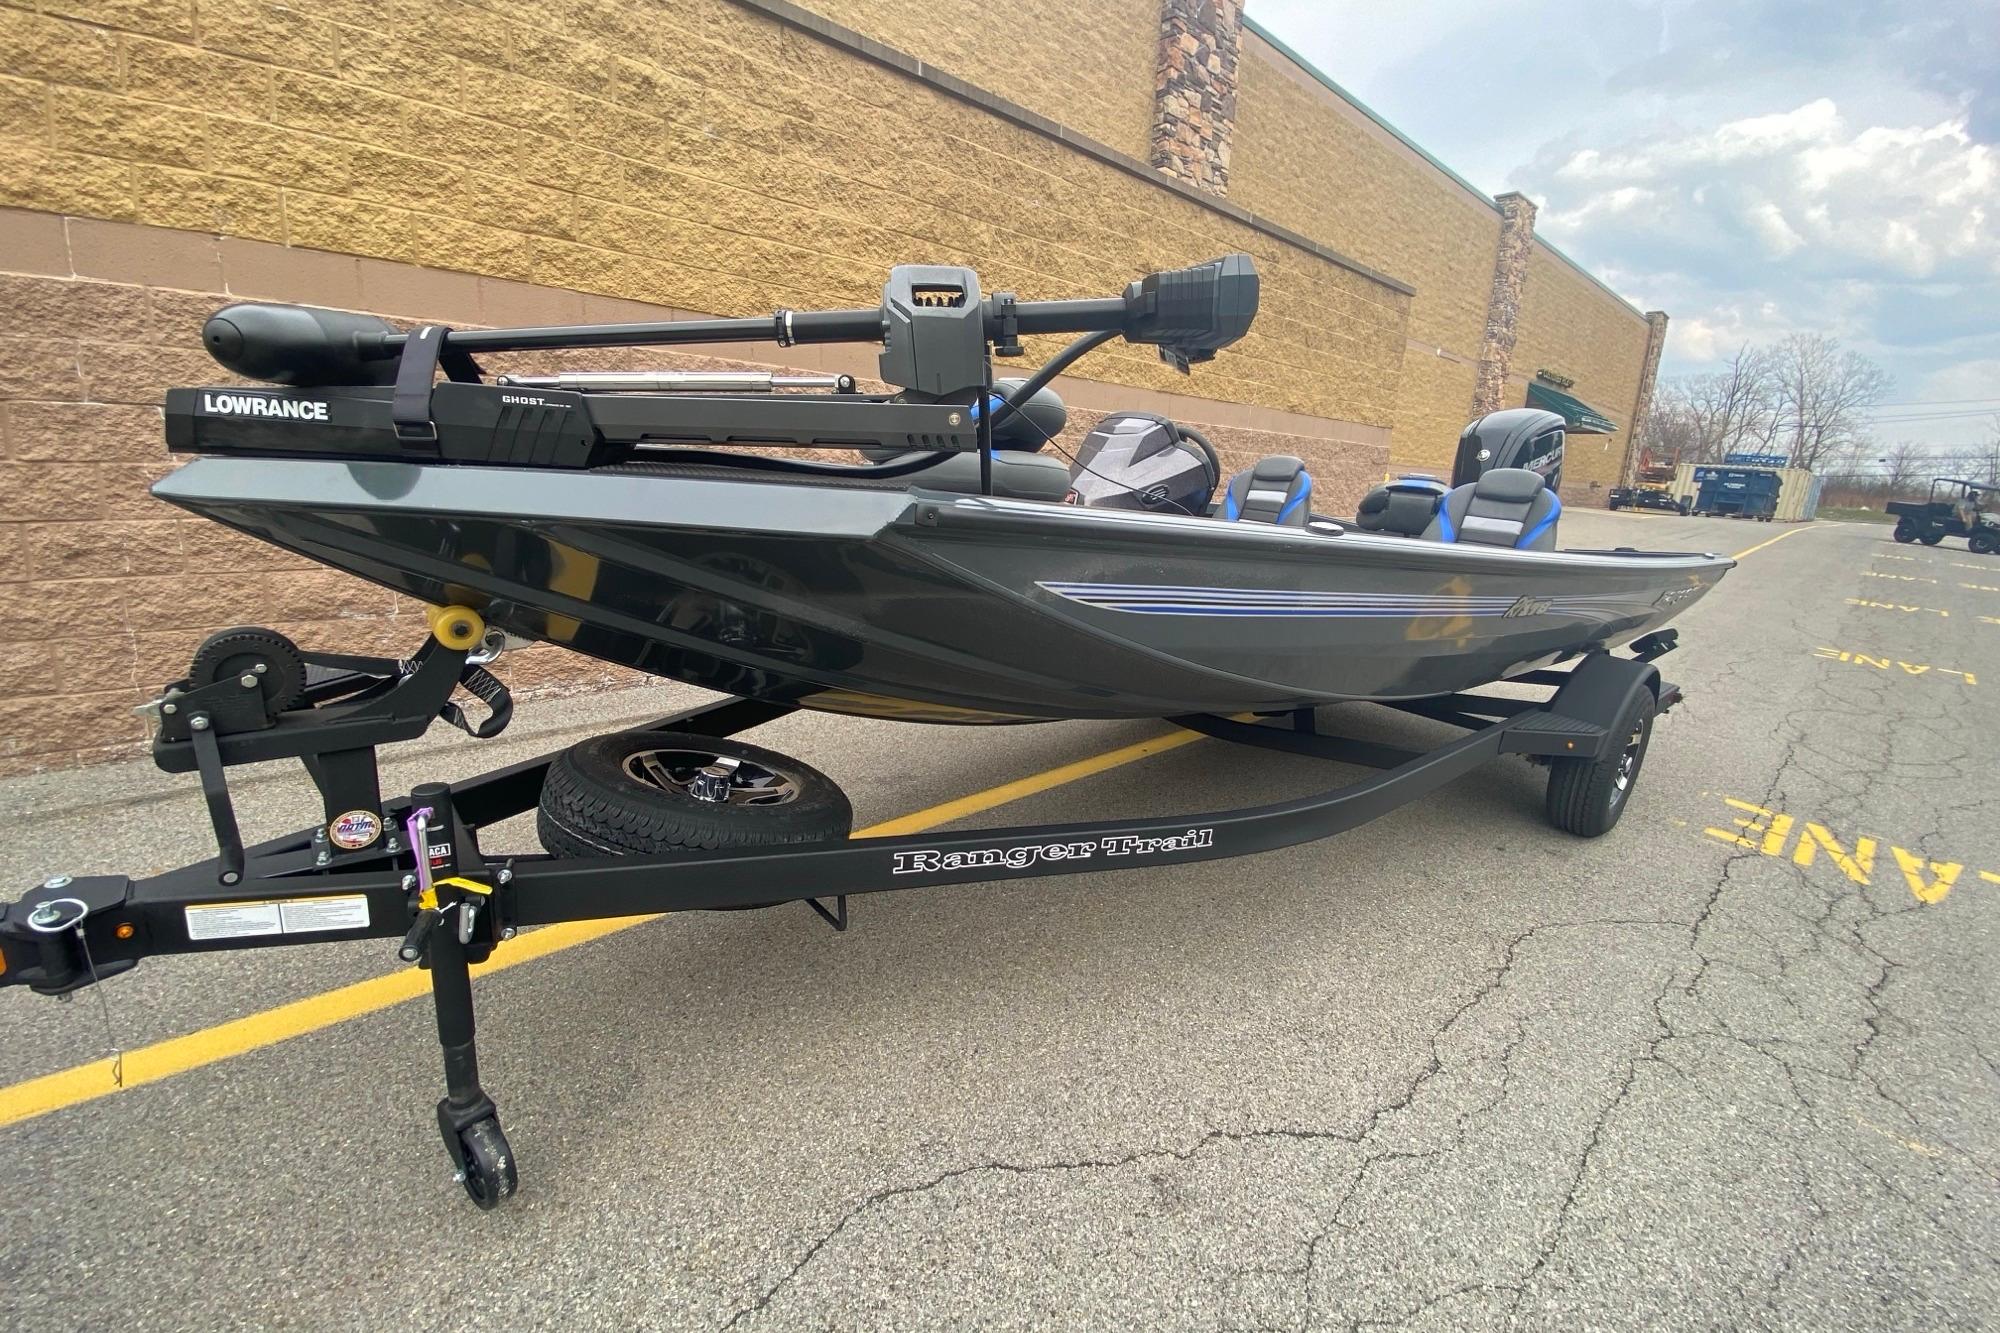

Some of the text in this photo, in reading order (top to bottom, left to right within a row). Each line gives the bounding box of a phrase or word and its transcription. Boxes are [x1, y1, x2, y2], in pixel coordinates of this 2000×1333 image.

[204, 394, 328, 420] LOWRANCE
[502, 395, 545, 406] GHOST
[1522, 446, 1563, 471] MERCUR
[1843, 598, 1949, 617] LANE
[1812, 646, 1977, 685] LANE
[893, 828, 1214, 874] Ranger Trail
